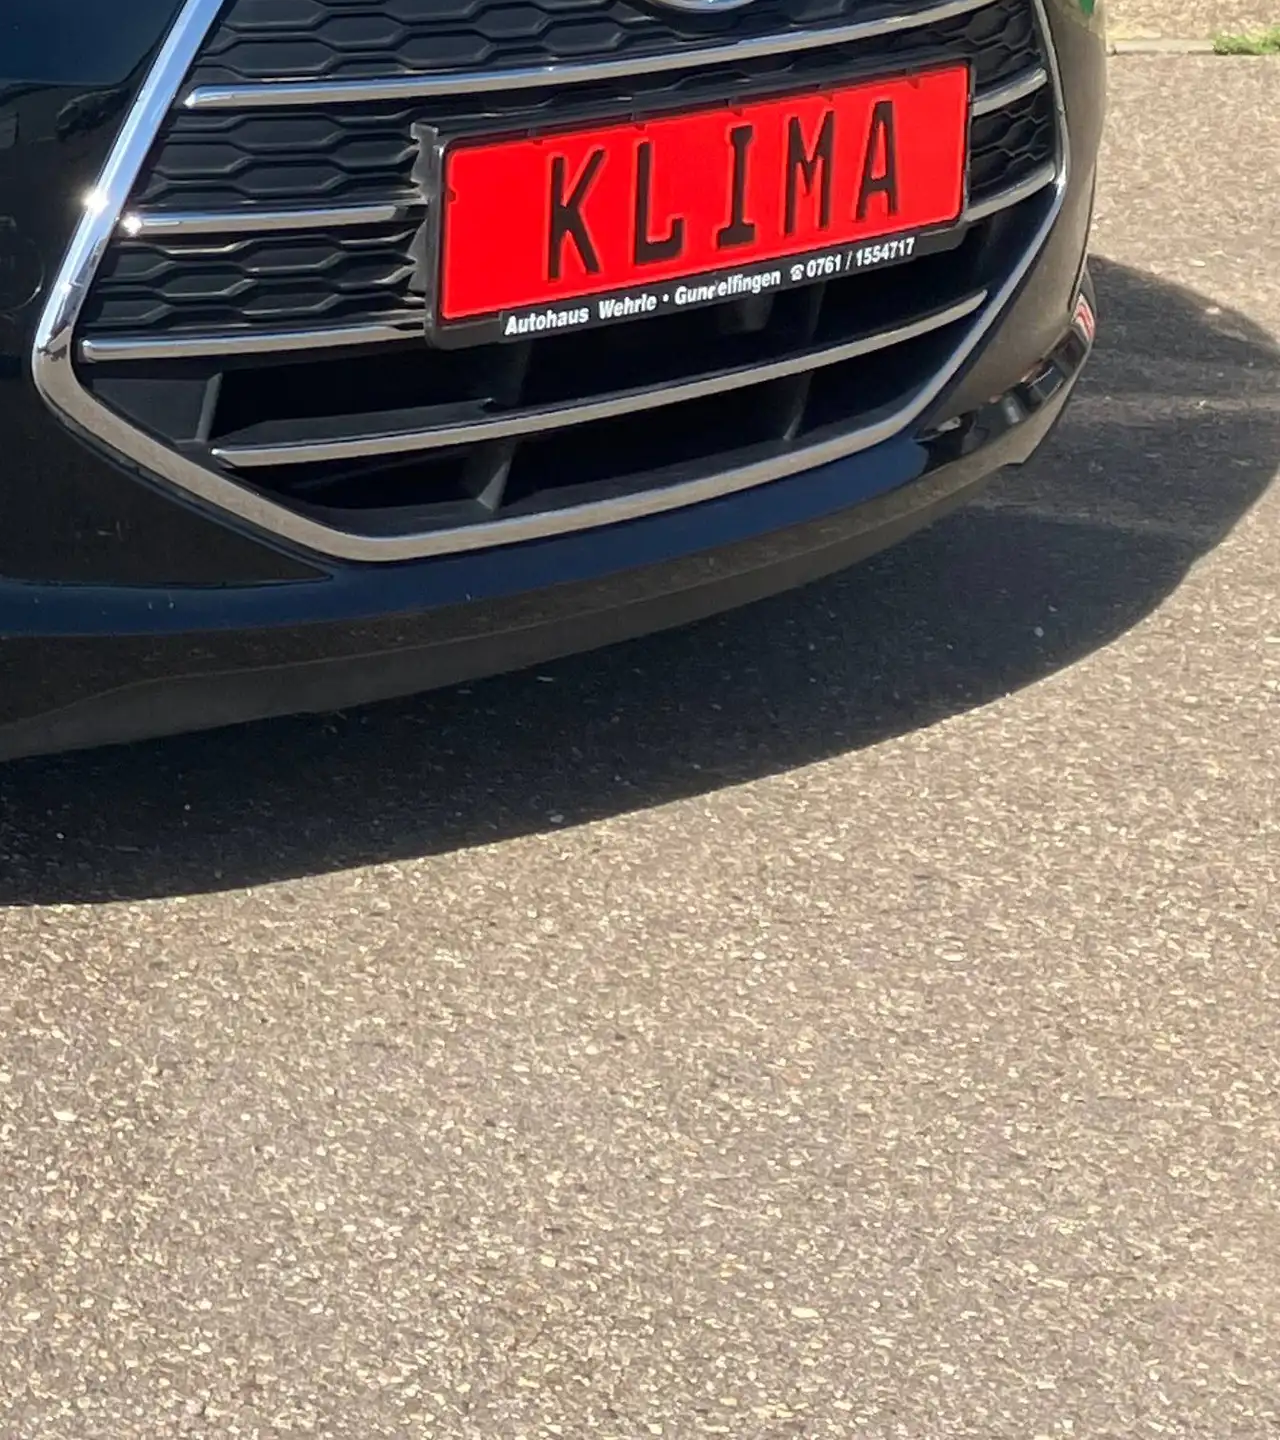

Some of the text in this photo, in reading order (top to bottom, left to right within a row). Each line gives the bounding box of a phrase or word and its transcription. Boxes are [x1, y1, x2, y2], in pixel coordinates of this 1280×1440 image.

[547, 100, 898, 282] KLIMA
[504, 307, 589, 336] Autohaus
[598, 294, 657, 320] Wehrle
[806, 253, 841, 278] 0761
[855, 237, 916, 267] 1554717
